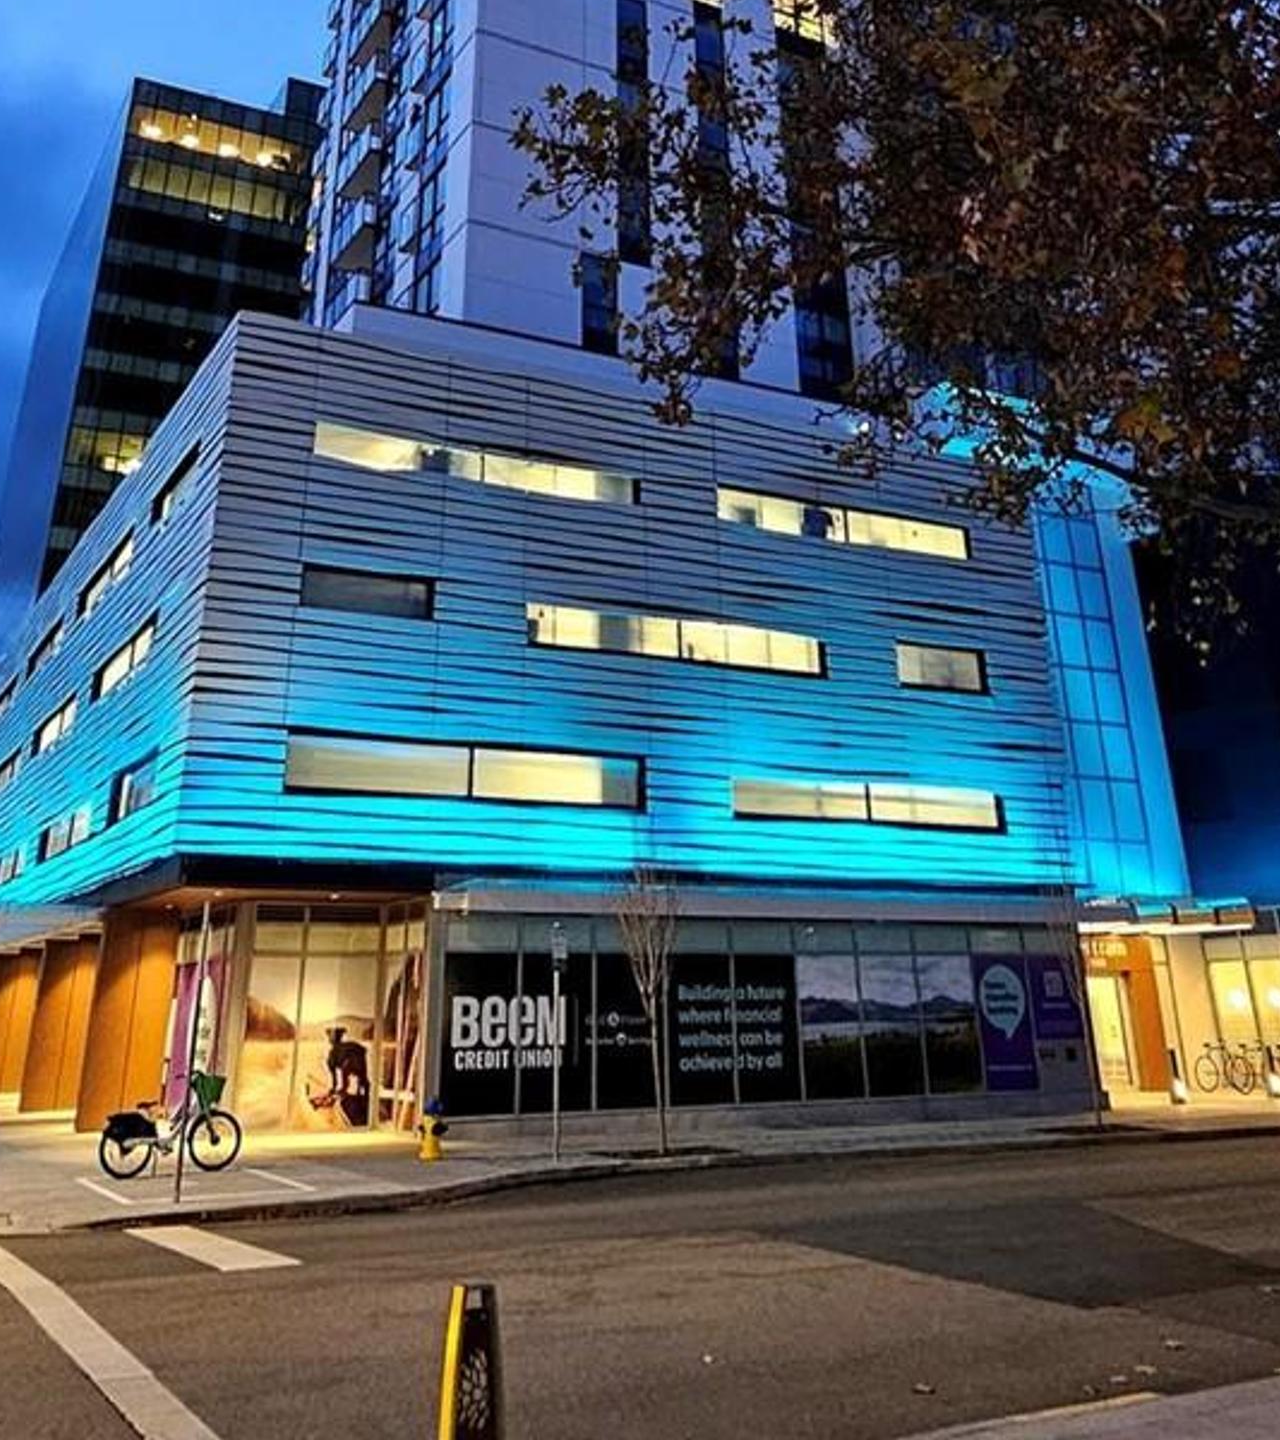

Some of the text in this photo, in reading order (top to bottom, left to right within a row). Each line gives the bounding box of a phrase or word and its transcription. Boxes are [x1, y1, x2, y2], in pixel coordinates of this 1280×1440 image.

[724, 1006, 782, 1022] fnancial
[739, 1033, 763, 1047] can
[765, 1029, 783, 1045] be
[454, 1049, 509, 1071] CREDIT
[747, 1052, 763, 1071] by
[765, 1051, 783, 1068] all
